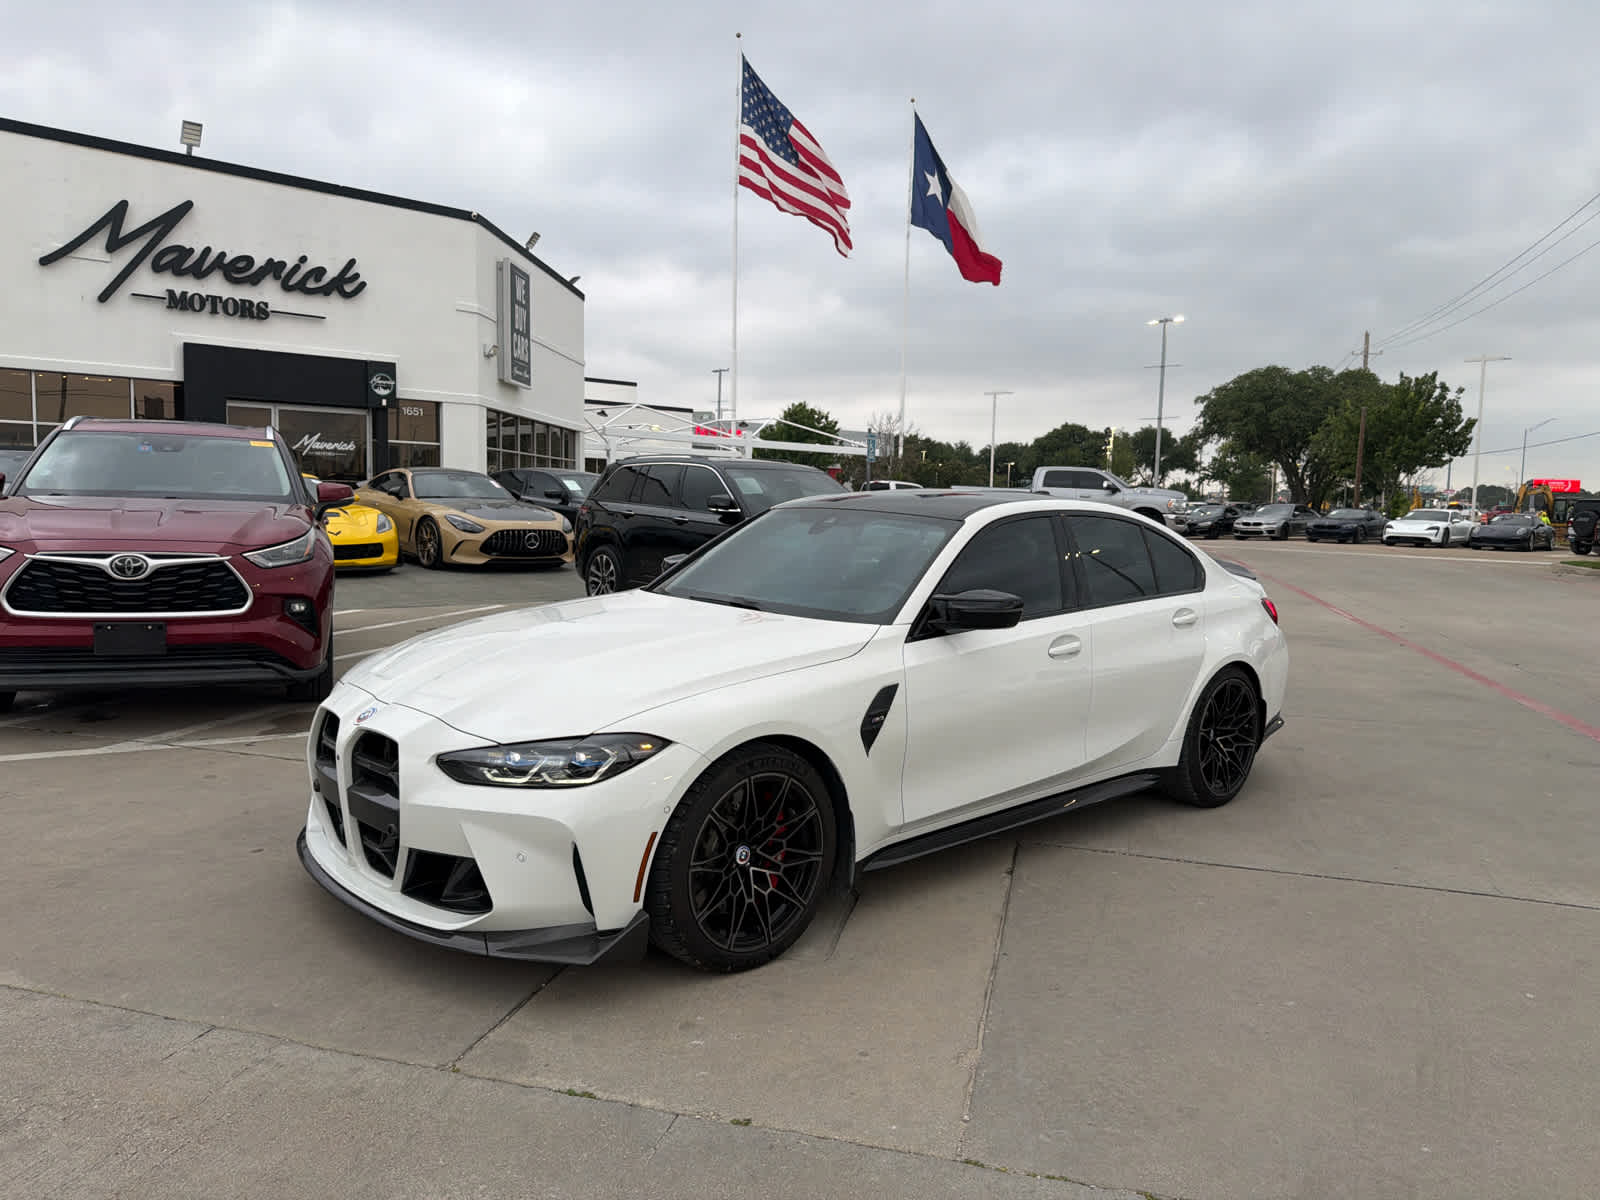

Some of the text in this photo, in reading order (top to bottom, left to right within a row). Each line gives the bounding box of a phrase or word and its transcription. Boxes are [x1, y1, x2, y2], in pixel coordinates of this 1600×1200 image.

[38, 199, 367, 303] Maverick
[165, 289, 271, 321] MOTORS
[515, 275, 526, 304] WE
[514, 303, 527, 334] BUY
[512, 332, 529, 363] CARS
[402, 406, 424, 417] 1651
[292, 432, 356, 456] Maverick
